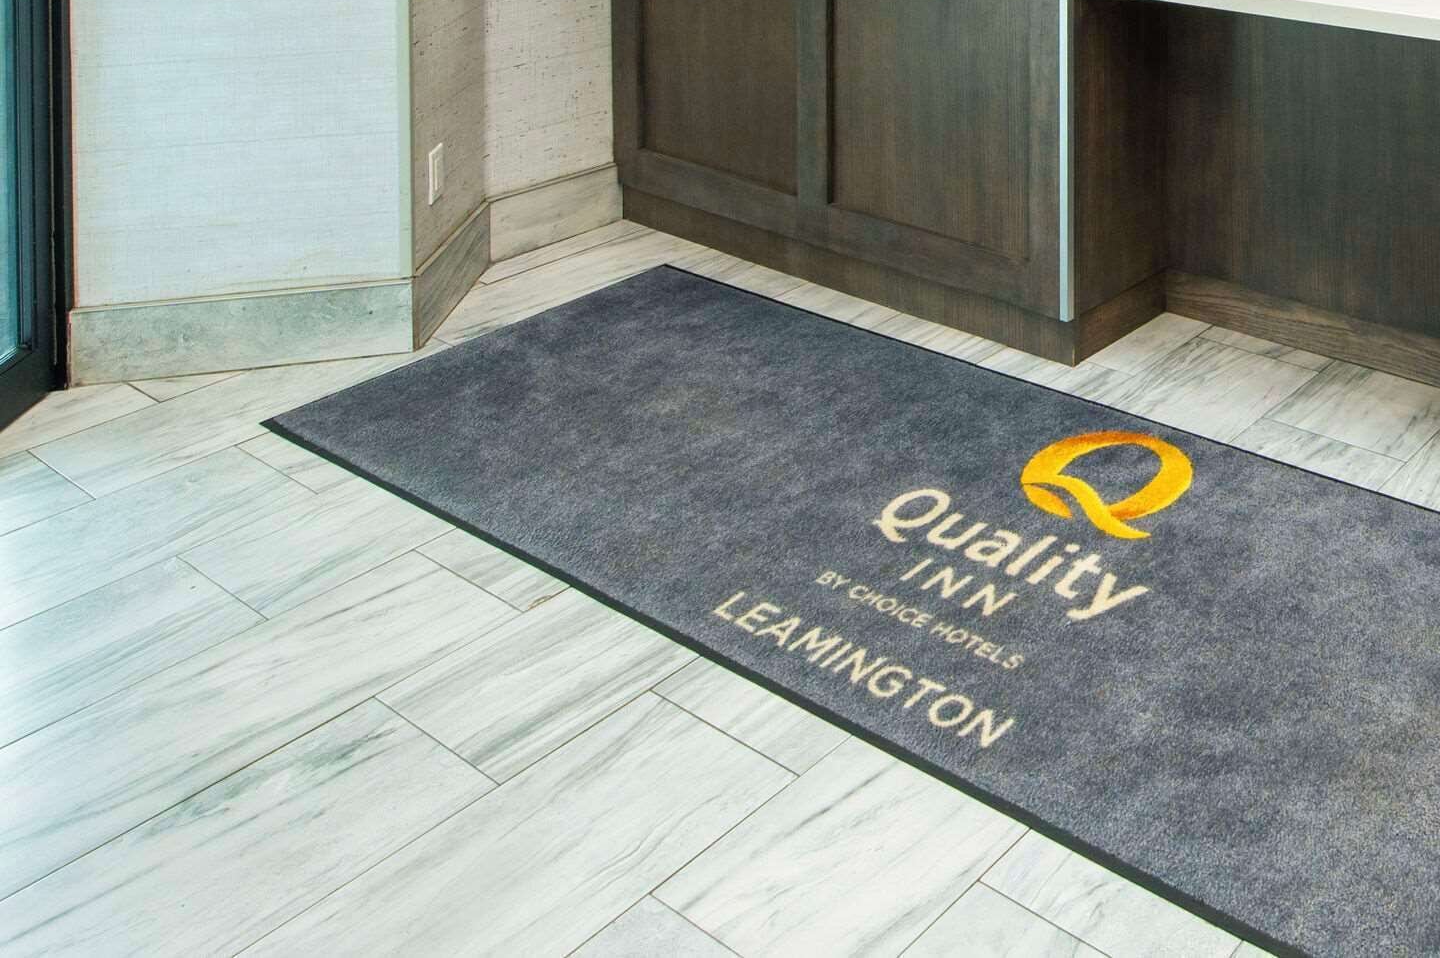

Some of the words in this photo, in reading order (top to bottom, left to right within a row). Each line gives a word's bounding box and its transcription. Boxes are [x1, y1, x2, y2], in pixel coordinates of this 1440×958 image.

[873, 488, 1151, 621] Quality
[900, 557, 1019, 618] INN
[711, 590, 1018, 748] LEAMINGTON
[815, 571, 852, 591] BY
[848, 580, 936, 630] CHOICE
[930, 621, 1025, 671] HOTELS
